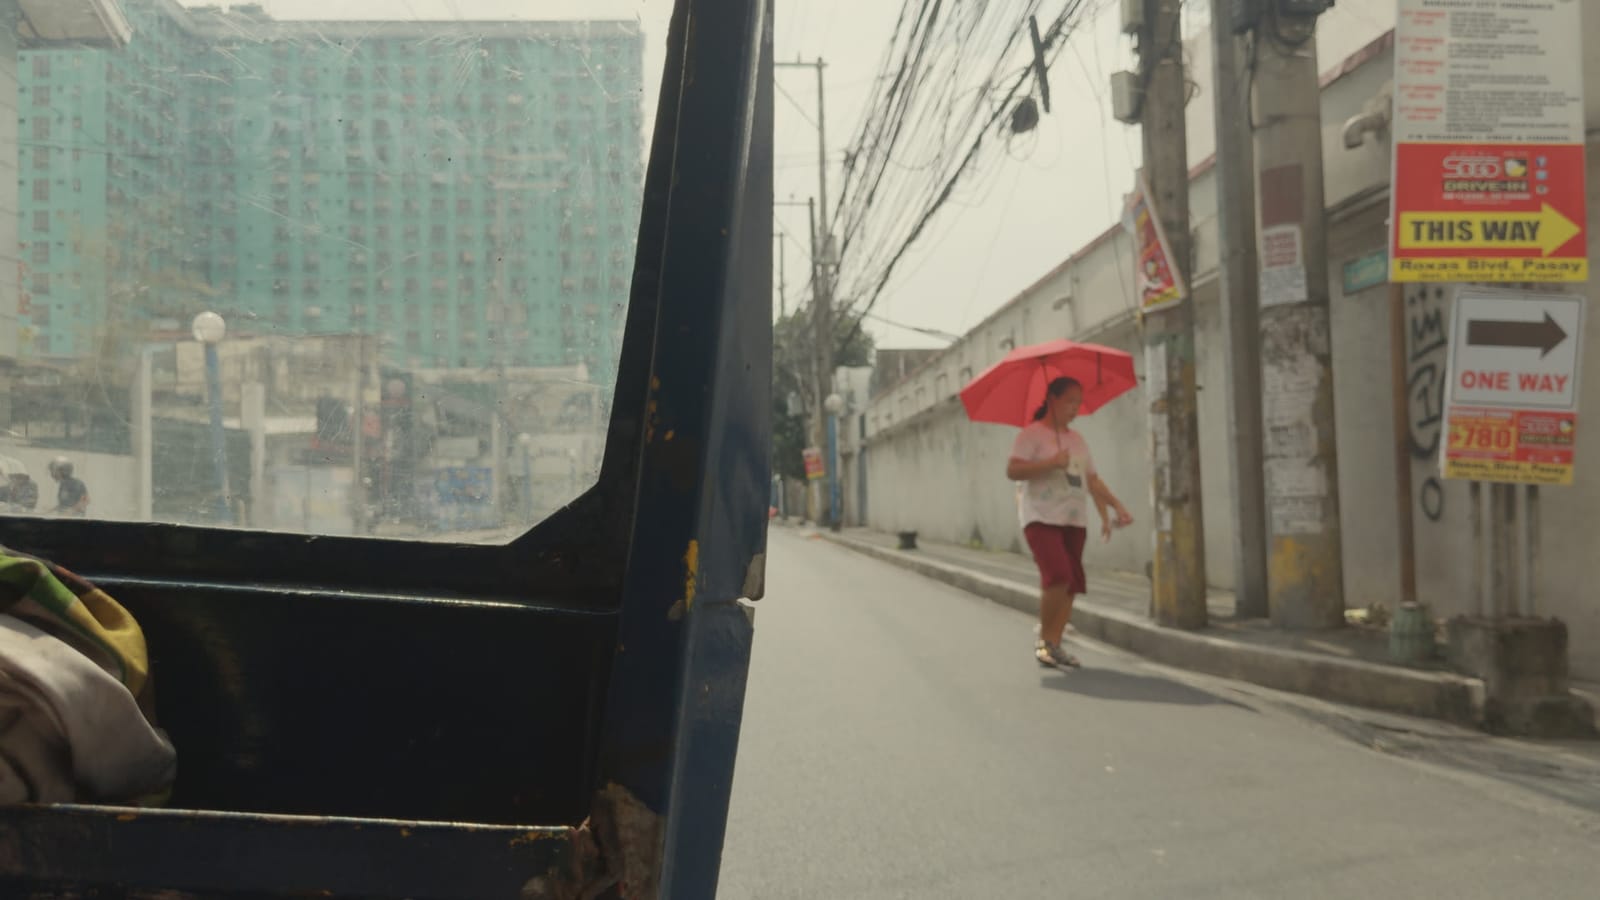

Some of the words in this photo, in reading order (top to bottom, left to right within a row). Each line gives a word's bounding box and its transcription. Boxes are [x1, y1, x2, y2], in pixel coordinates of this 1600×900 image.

[1443, 180, 1528, 192] DRIVE-IN
[1411, 220, 1474, 242] THIS
[1481, 221, 1541, 242] WAY
[1400, 260, 1460, 271] Roxas
[1522, 260, 1582, 274] Pasay
[1460, 370, 1511, 391] ONE
[1518, 373, 1569, 393] WAY
